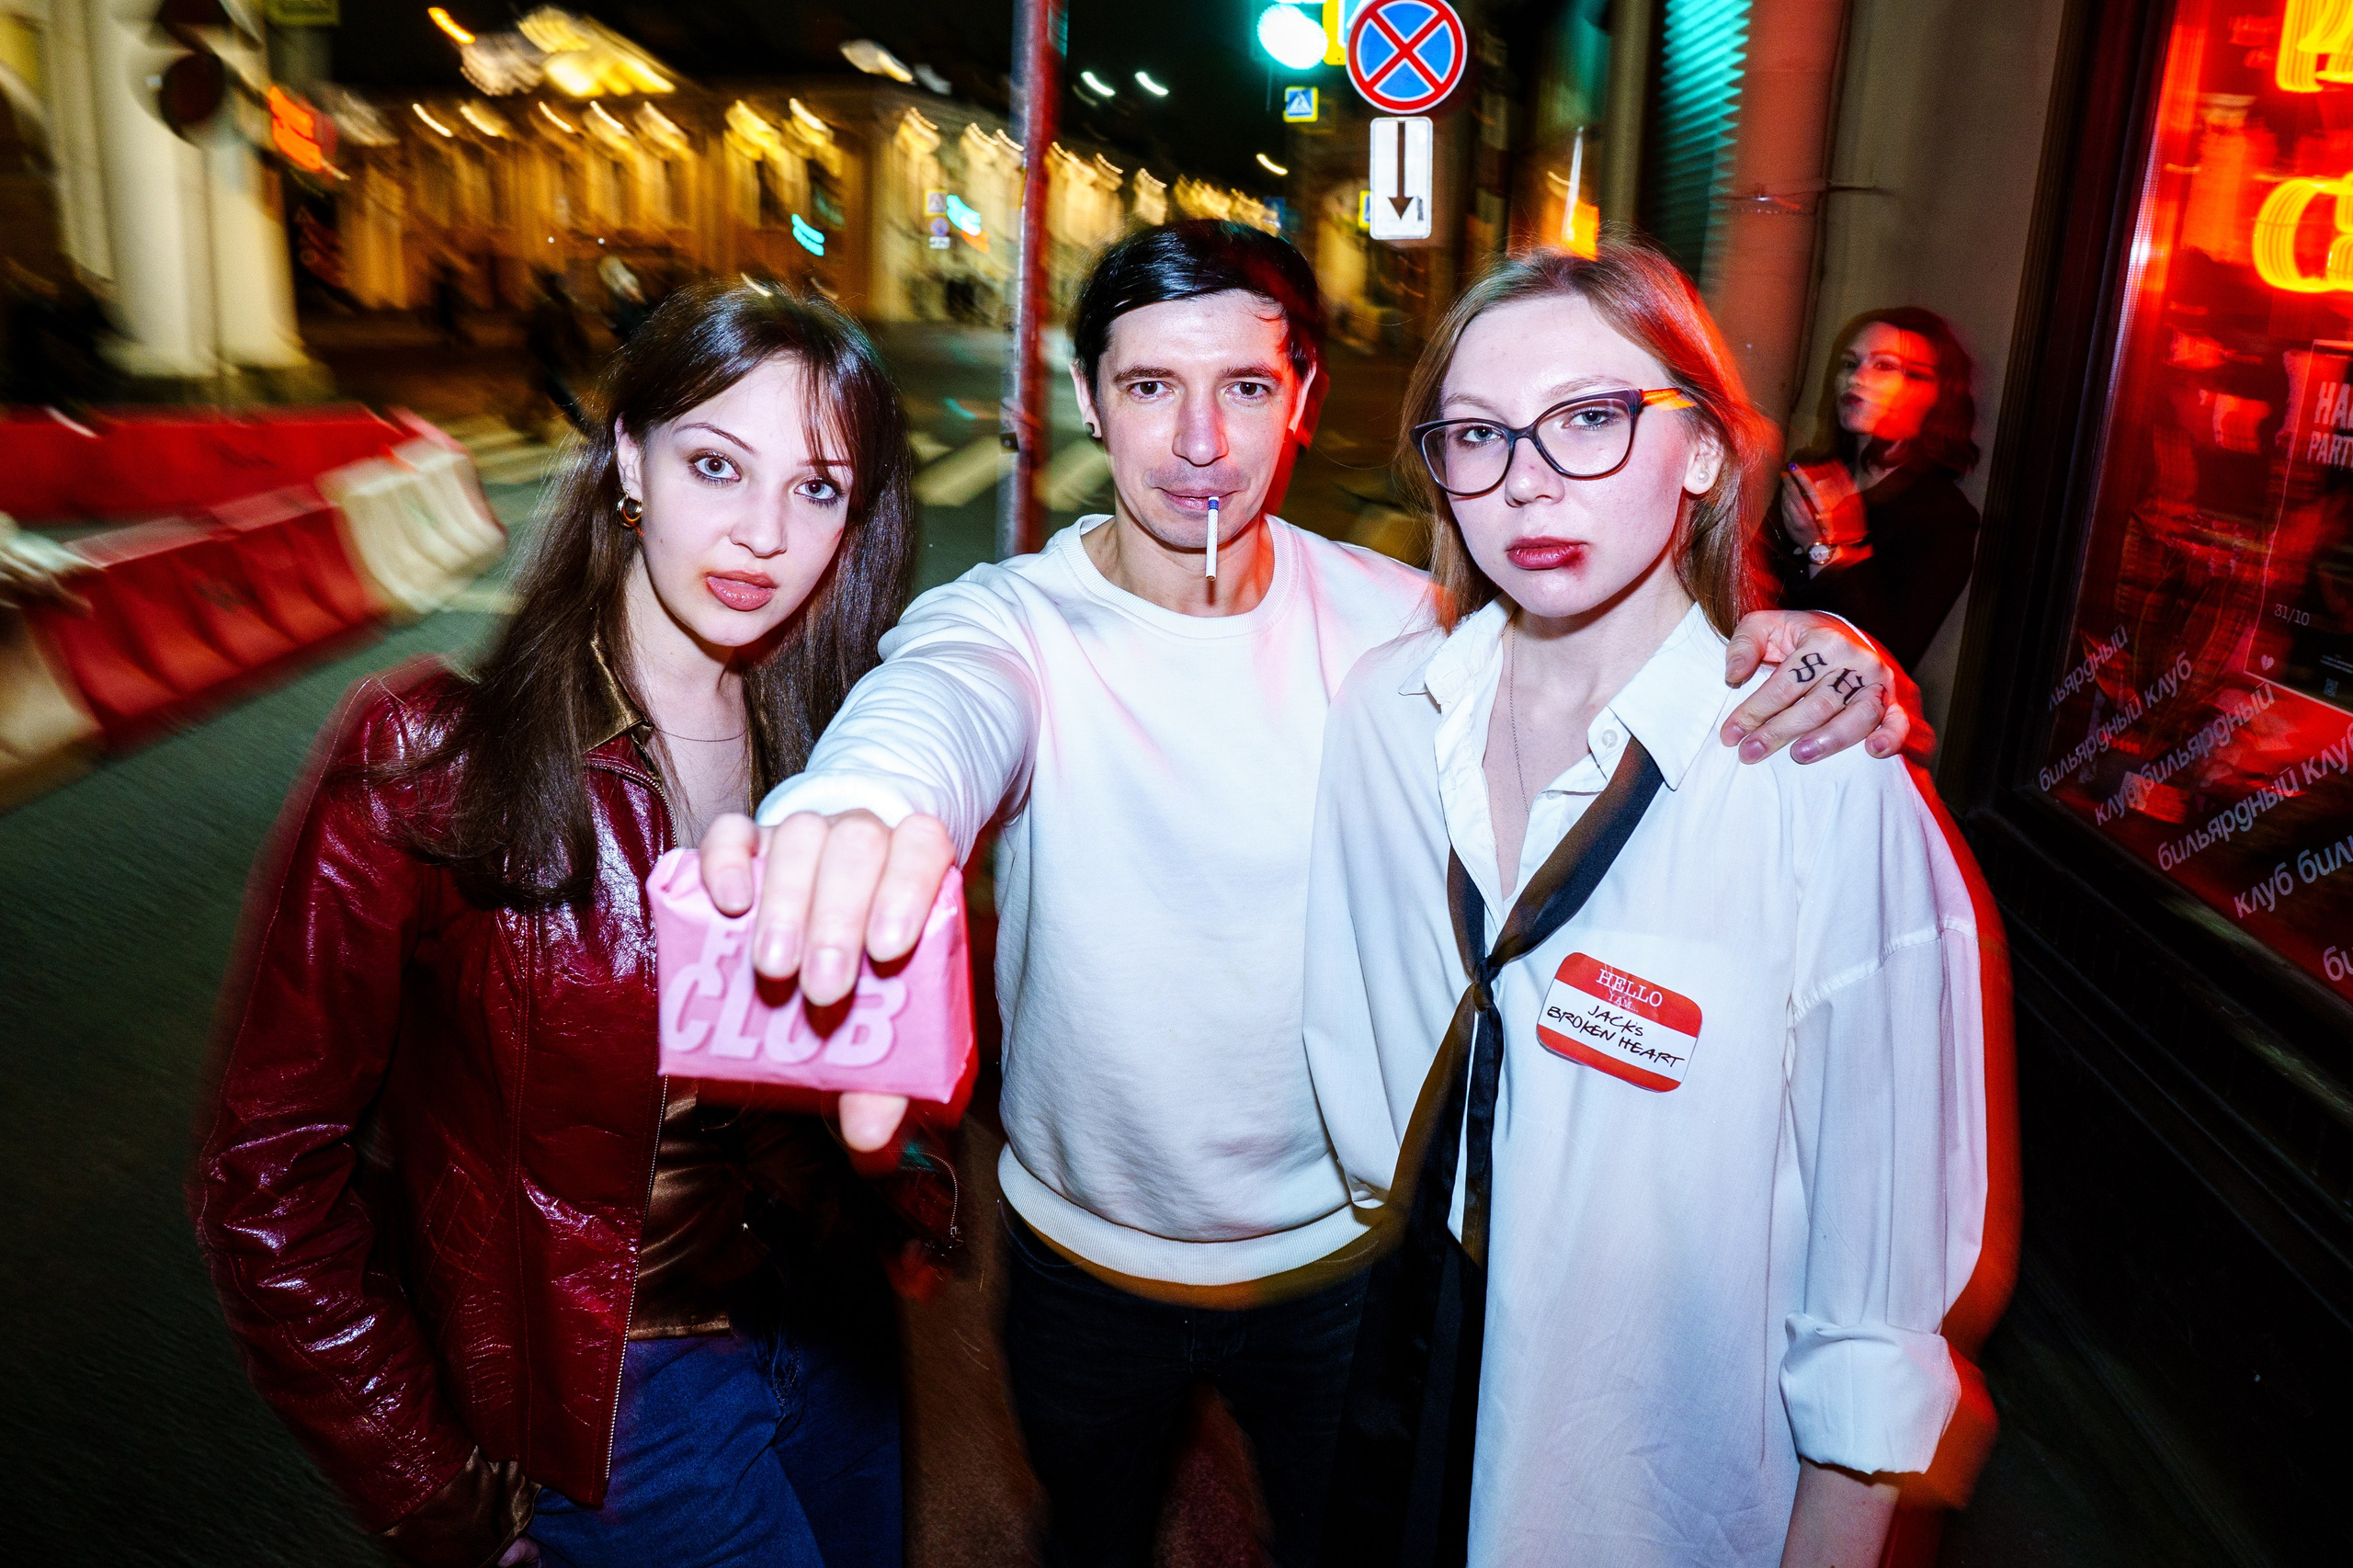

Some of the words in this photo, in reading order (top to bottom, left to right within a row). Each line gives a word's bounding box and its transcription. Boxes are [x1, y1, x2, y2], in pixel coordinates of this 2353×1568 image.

[2306, 430, 2353, 470] PART
[2274, 603, 2310, 626] 31/10
[2039, 695, 2143, 792] бильярдный
[2143, 651, 2191, 709] клуб
[2095, 781, 2139, 826] клуб
[2141, 681, 2275, 791] бильярдный
[2158, 767, 2300, 871] бильярдный
[2234, 861, 2293, 919] клуб
[1596, 968, 1663, 1007] HELLO
[1546, 1006, 1617, 1040] BROKEN
[1618, 1037, 1686, 1067] HEART
